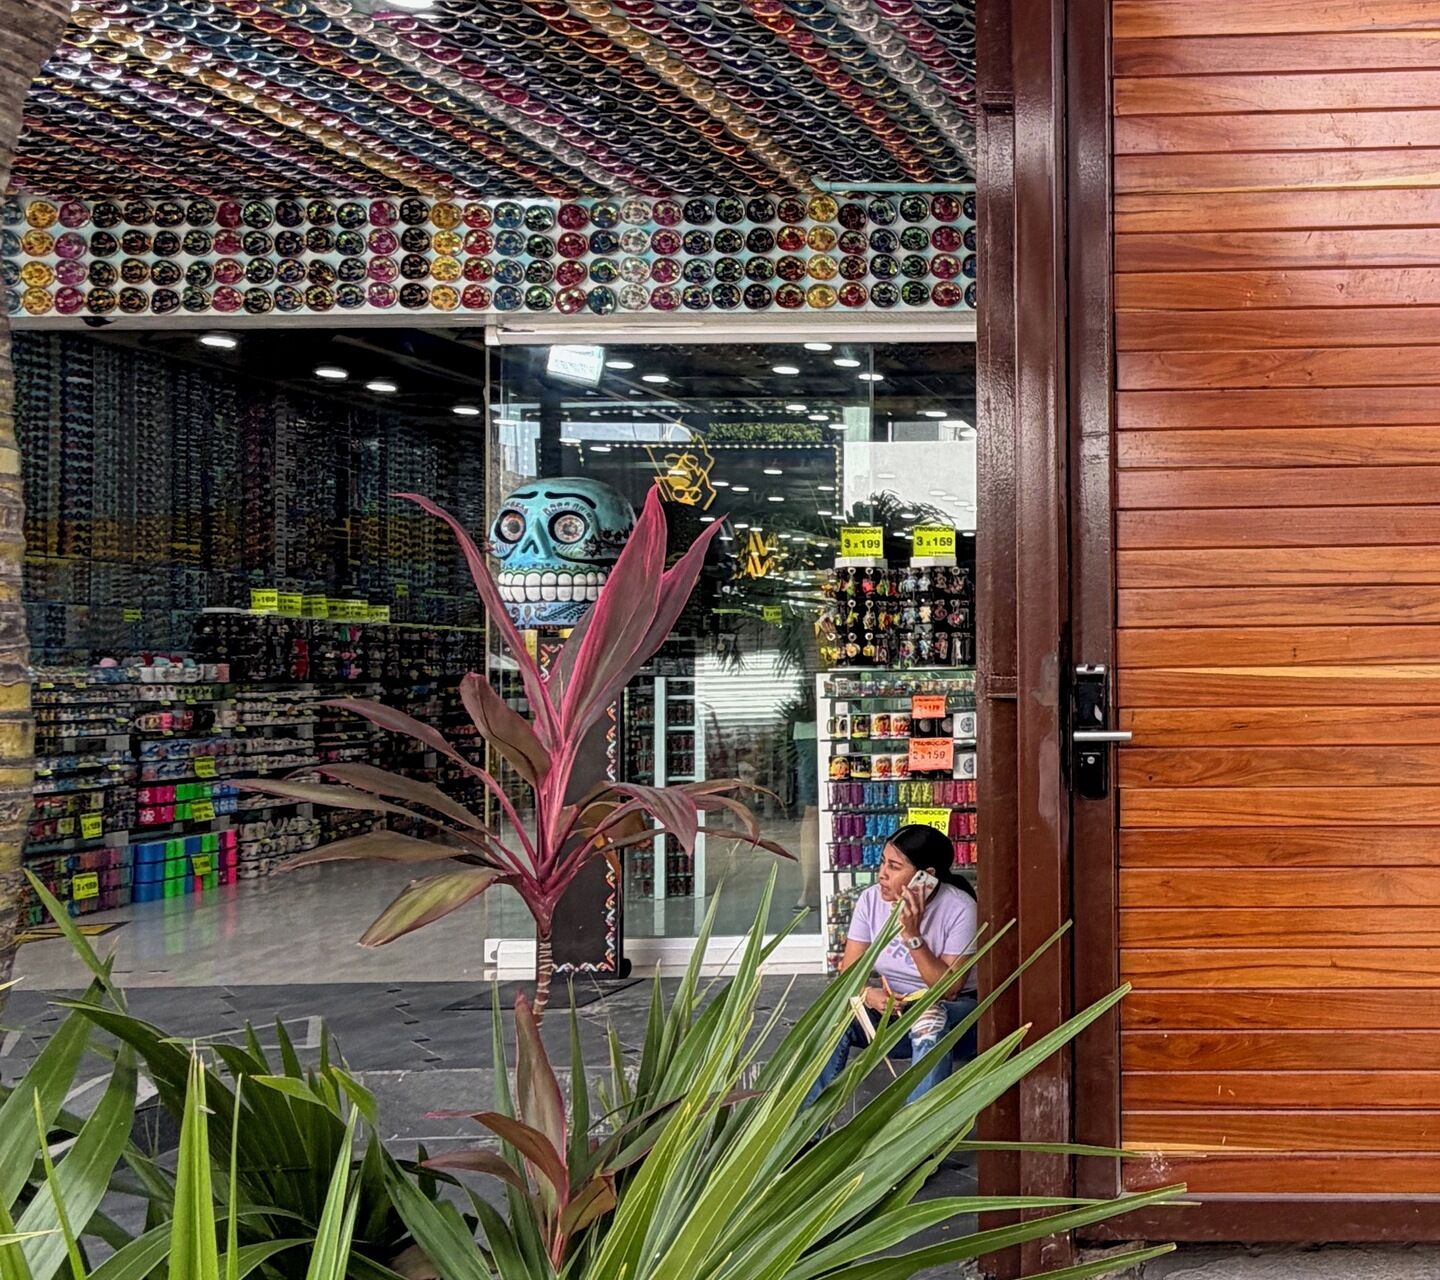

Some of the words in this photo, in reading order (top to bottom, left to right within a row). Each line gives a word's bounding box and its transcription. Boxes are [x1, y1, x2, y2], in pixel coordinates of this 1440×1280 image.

[844, 539, 851, 549] 3
[860, 539, 881, 549] 199
[916, 536, 923, 546] 3
[913, 751, 919, 760] 2
